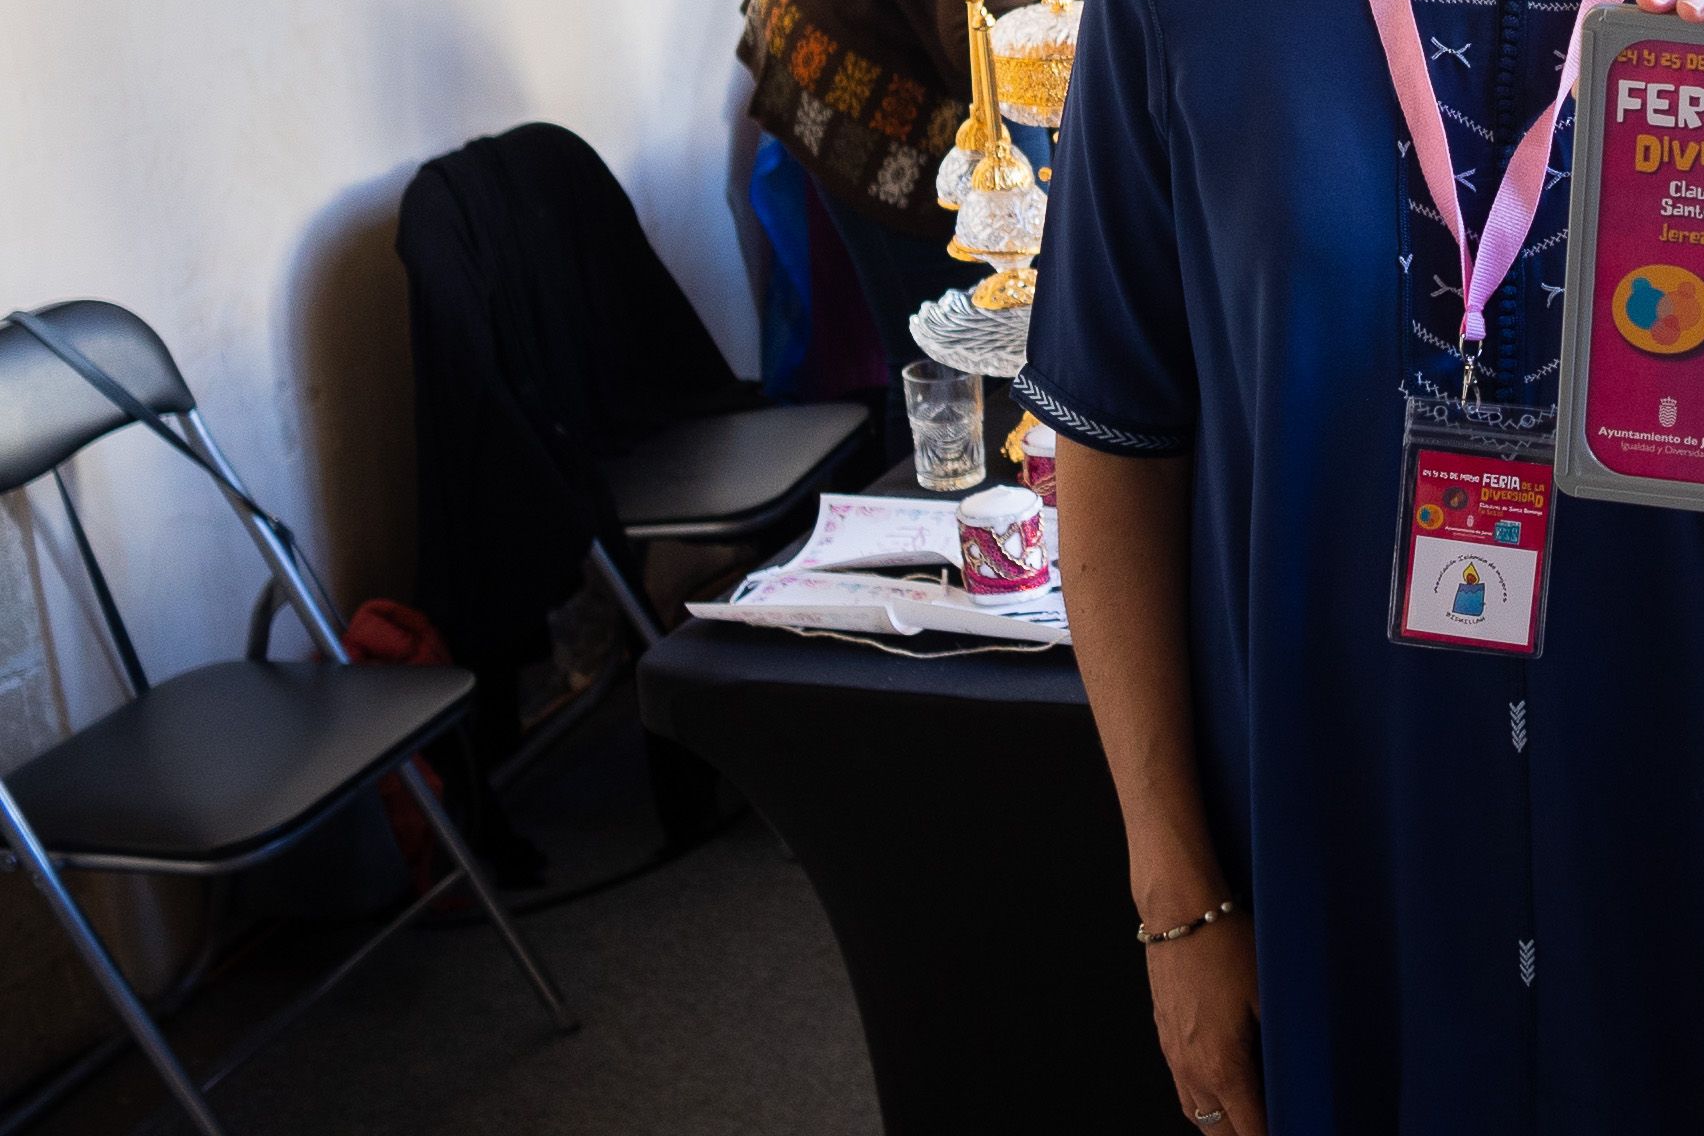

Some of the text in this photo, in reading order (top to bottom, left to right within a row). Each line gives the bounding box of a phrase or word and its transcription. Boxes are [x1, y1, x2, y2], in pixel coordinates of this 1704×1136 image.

[1661, 52, 1681, 69] 25
[1599, 426, 1681, 444] Ayuntamiento
[1684, 435, 1698, 445] de
[1621, 441, 1655, 453] Igualdad
[1482, 473, 1520, 490] FERIA
[1521, 482, 1531, 490] DE
